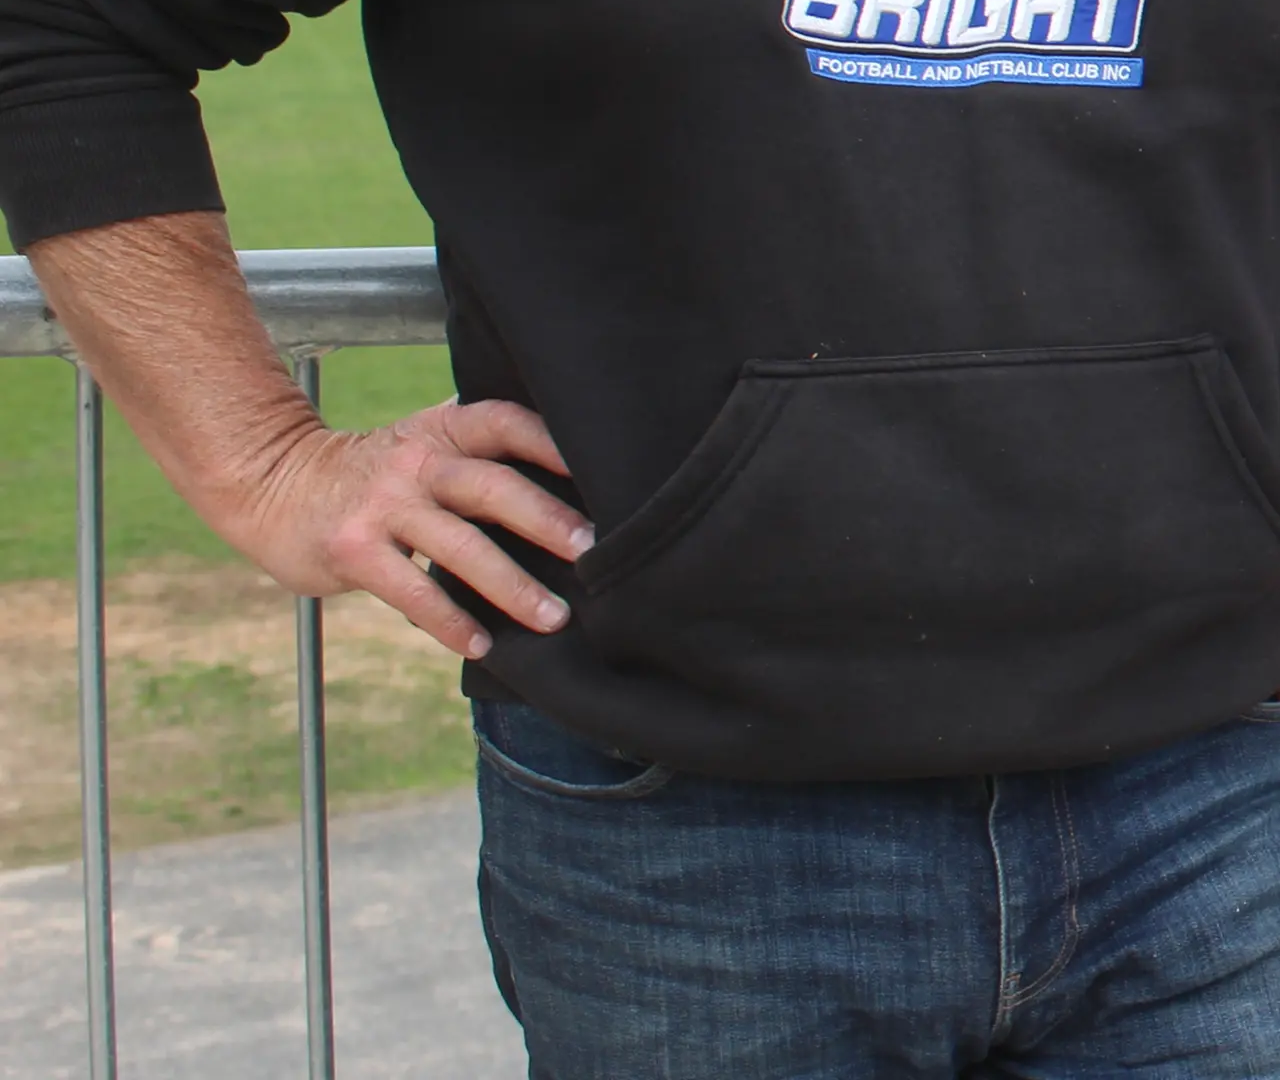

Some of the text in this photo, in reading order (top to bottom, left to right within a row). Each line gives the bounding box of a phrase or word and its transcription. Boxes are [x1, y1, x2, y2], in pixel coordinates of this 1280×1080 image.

[818, 56, 1131, 81] FOOTBALL AND NETBALL CLUB INC
